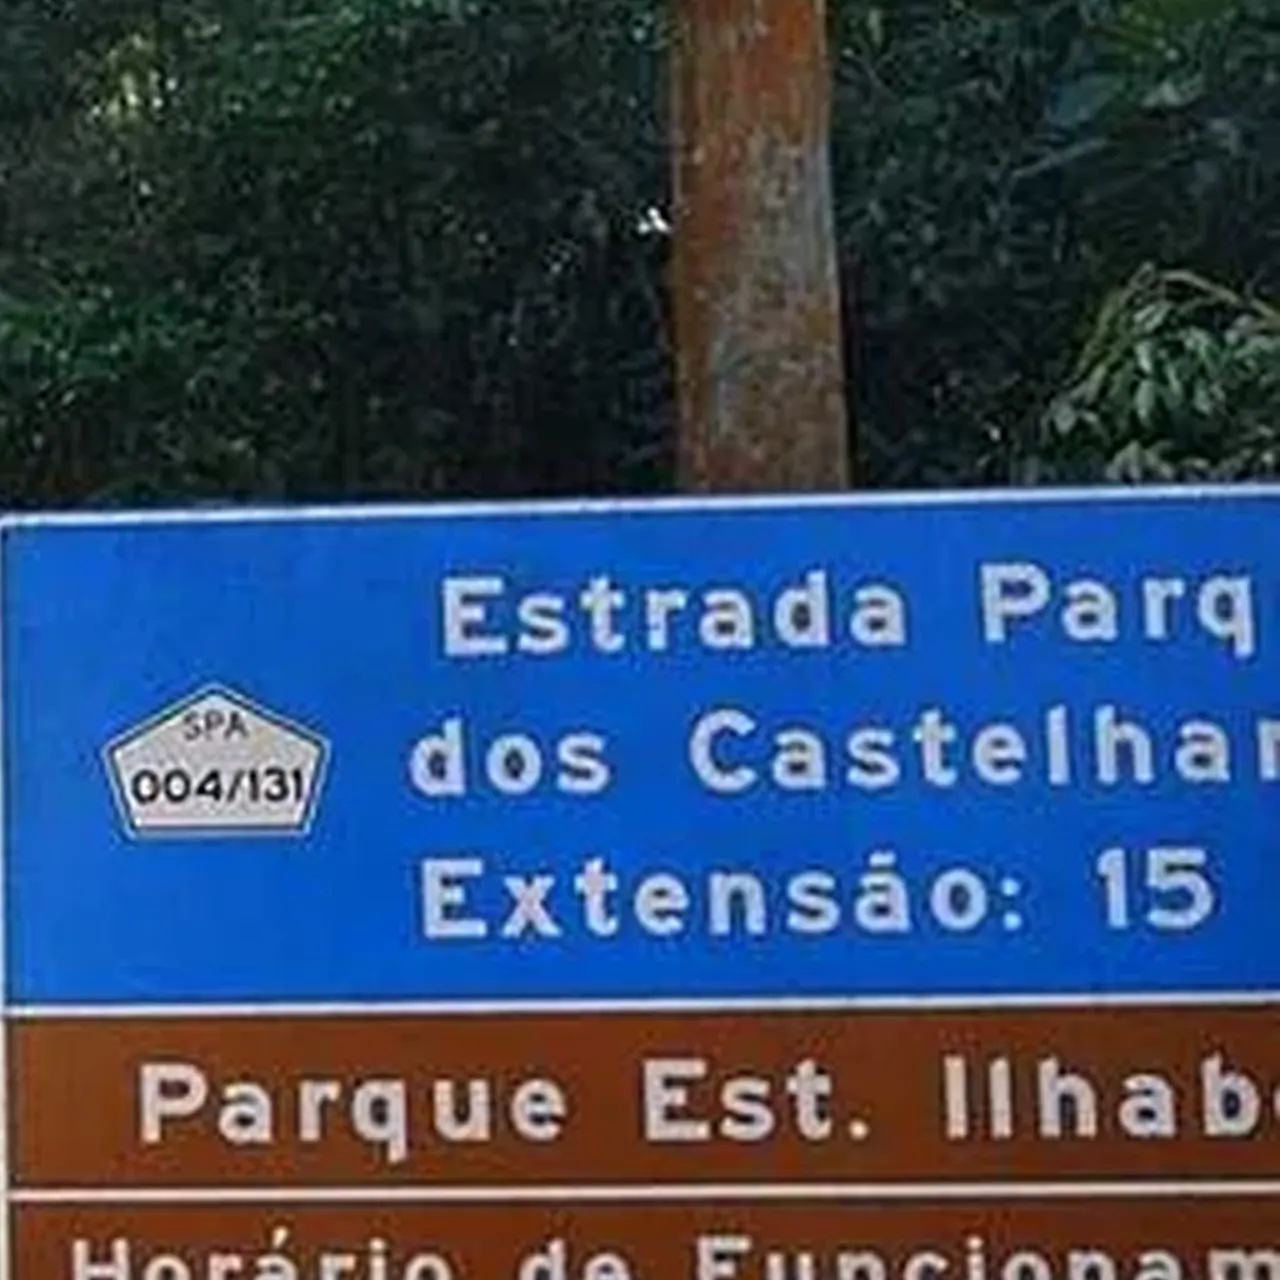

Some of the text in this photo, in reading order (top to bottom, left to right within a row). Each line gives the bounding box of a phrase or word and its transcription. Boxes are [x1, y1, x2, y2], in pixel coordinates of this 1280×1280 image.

[442, 561, 1255, 659] Estrada Parq
[182, 709, 249, 741] SPA
[408, 716, 611, 797] dos
[131, 766, 303, 805] 004/131
[421, 845, 1216, 939] Extensão: 15
[140, 1054, 1280, 1164] Parque Est. Ilhab
